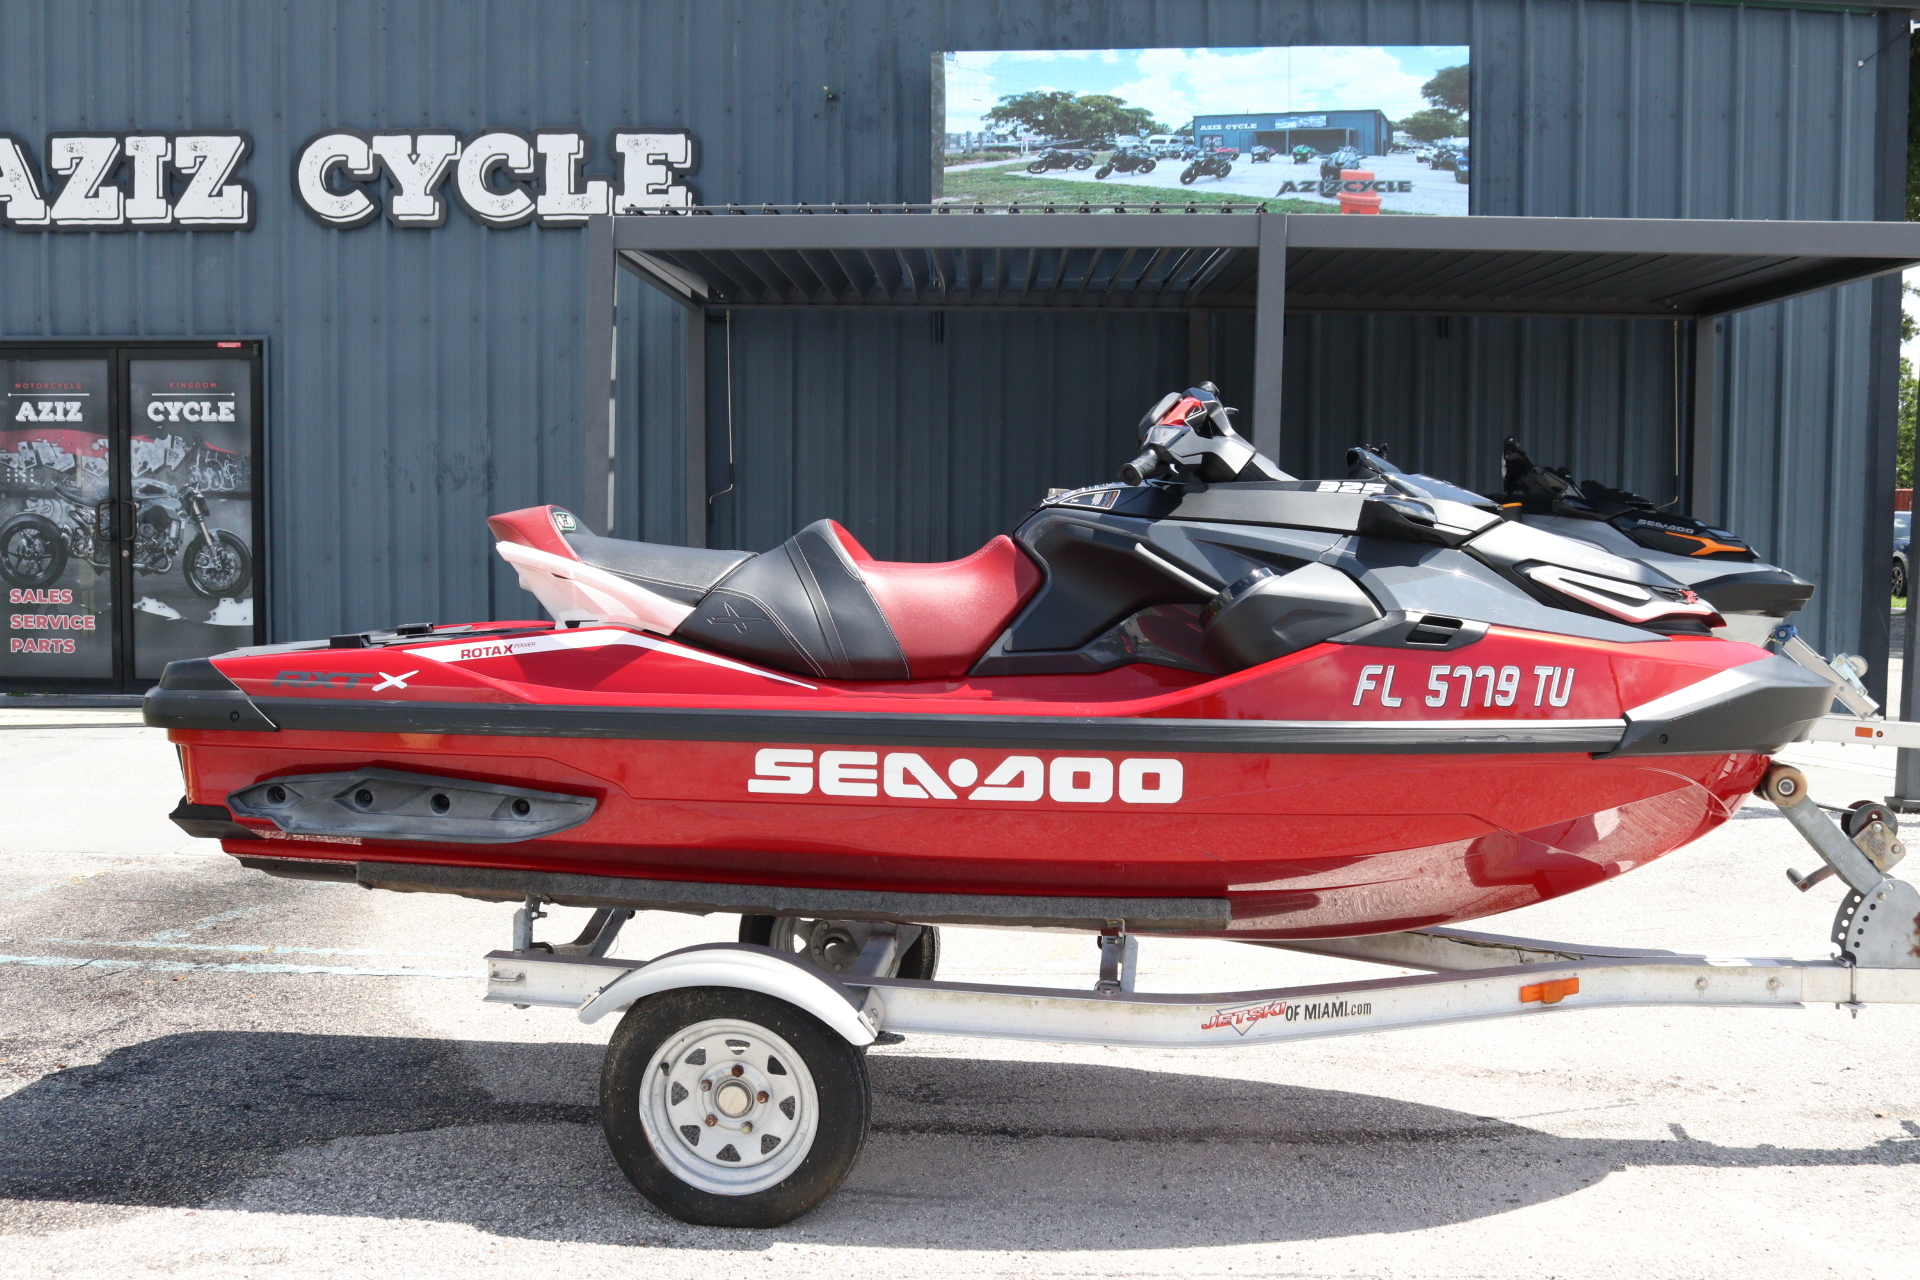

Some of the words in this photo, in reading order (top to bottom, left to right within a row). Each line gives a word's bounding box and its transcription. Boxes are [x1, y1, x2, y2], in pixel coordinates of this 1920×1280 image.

[0, 136, 248, 225] AZIZ
[298, 132, 693, 222] CYCLE
[15, 401, 83, 422] AZIZ
[147, 401, 235, 422] CYCLE
[10, 588, 73, 604] SALES
[10, 614, 96, 630] SERVICE
[10, 638, 76, 654] PARTS
[460, 643, 513, 659] ROTAX
[514, 641, 536, 649] POWER
[270, 670, 375, 689] RXT
[1352, 665, 1402, 707] FL
[1425, 665, 1521, 707] 5779
[1533, 665, 1575, 707] TU
[1201, 1001, 1287, 1030] JETSKI
[1285, 1004, 1301, 1022] OF
